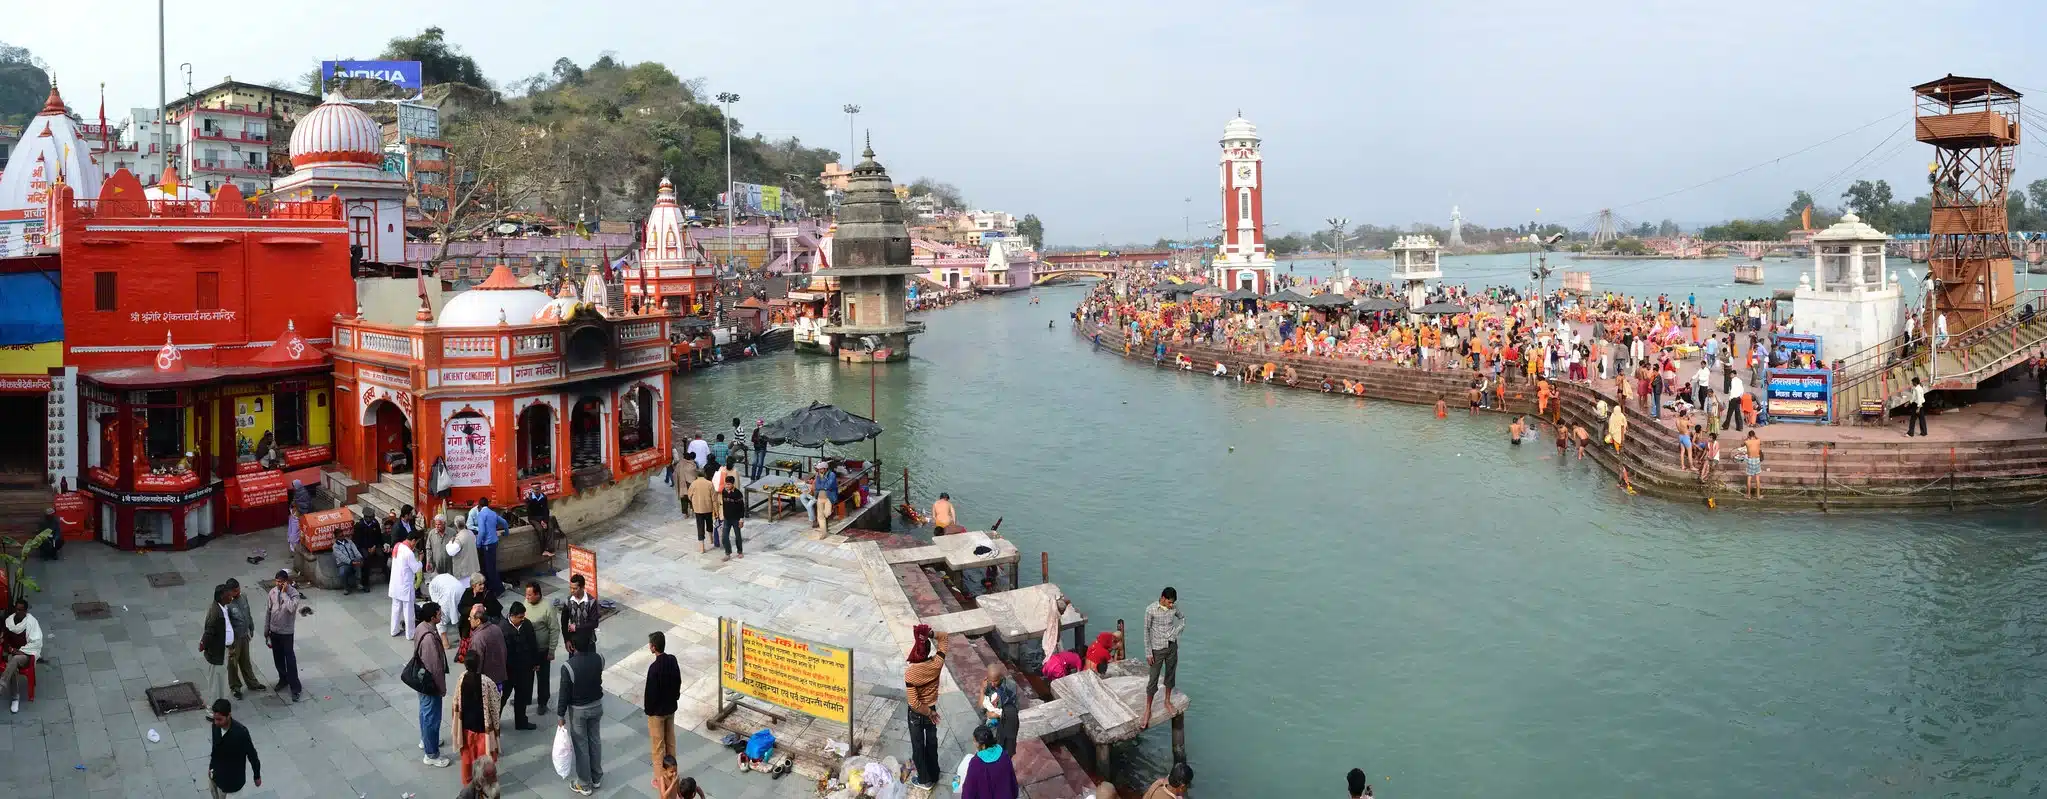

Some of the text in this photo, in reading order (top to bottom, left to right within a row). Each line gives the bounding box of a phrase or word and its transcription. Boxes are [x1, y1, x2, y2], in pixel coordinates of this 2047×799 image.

[80, 125, 113, 134] COSO
[516, 366, 533, 378] गंगा
[447, 434, 463, 447] गंगा
[315, 521, 354, 536] CHARITY BOX
